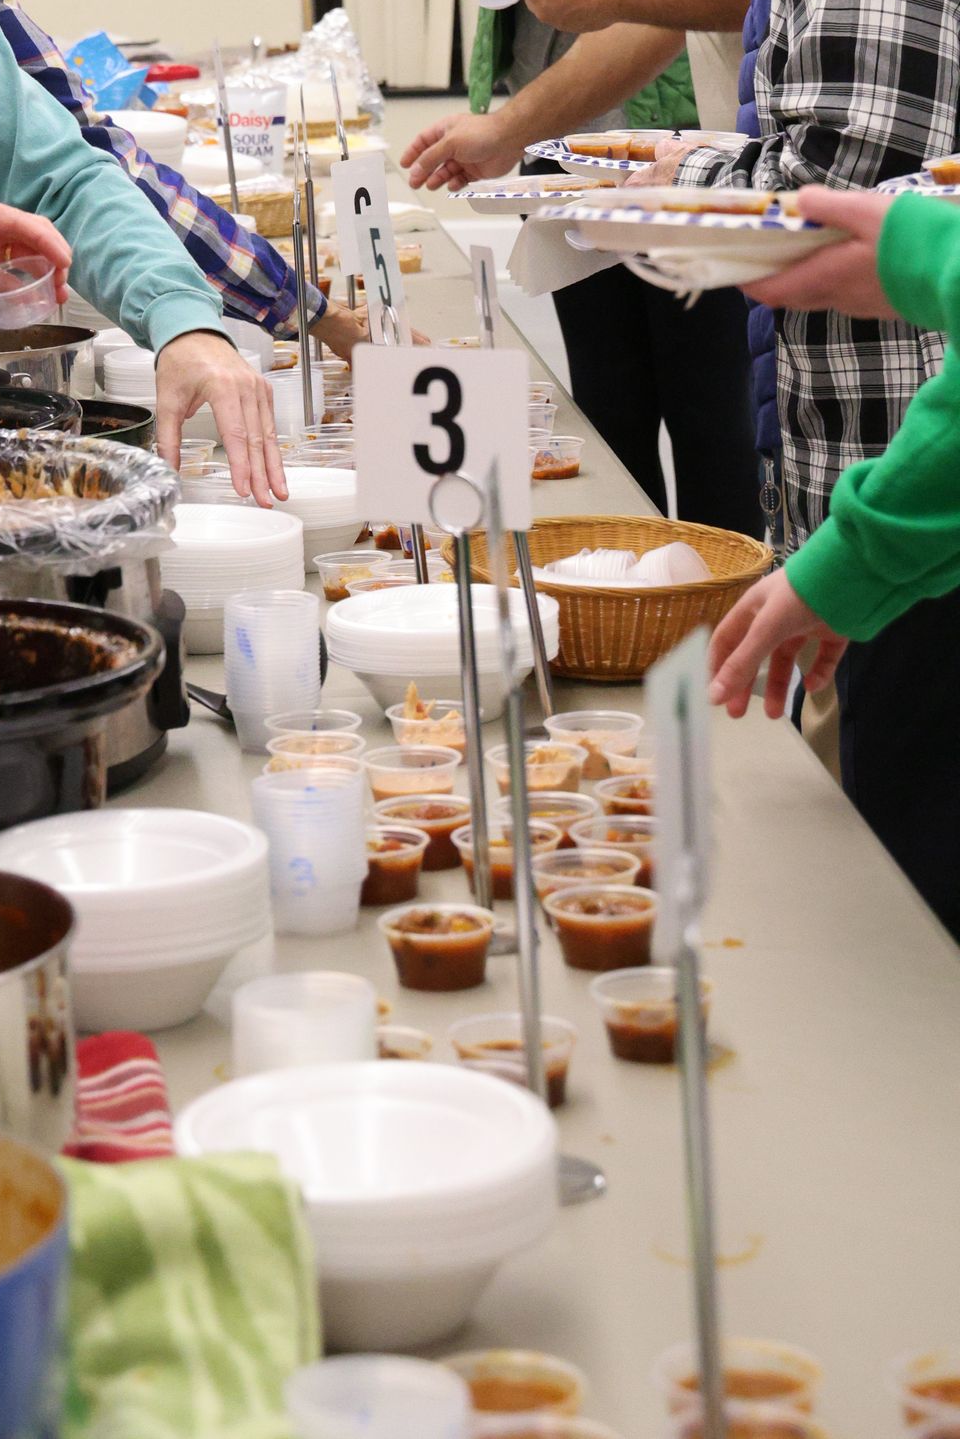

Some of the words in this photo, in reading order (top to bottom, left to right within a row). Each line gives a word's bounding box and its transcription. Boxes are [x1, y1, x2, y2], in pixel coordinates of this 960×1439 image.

[228, 113, 272, 131] Daisy
[233, 134, 270, 146] SOUR
[235, 145, 274, 157] REAM
[369, 227, 392, 307] 5
[412, 366, 465, 475] 3
